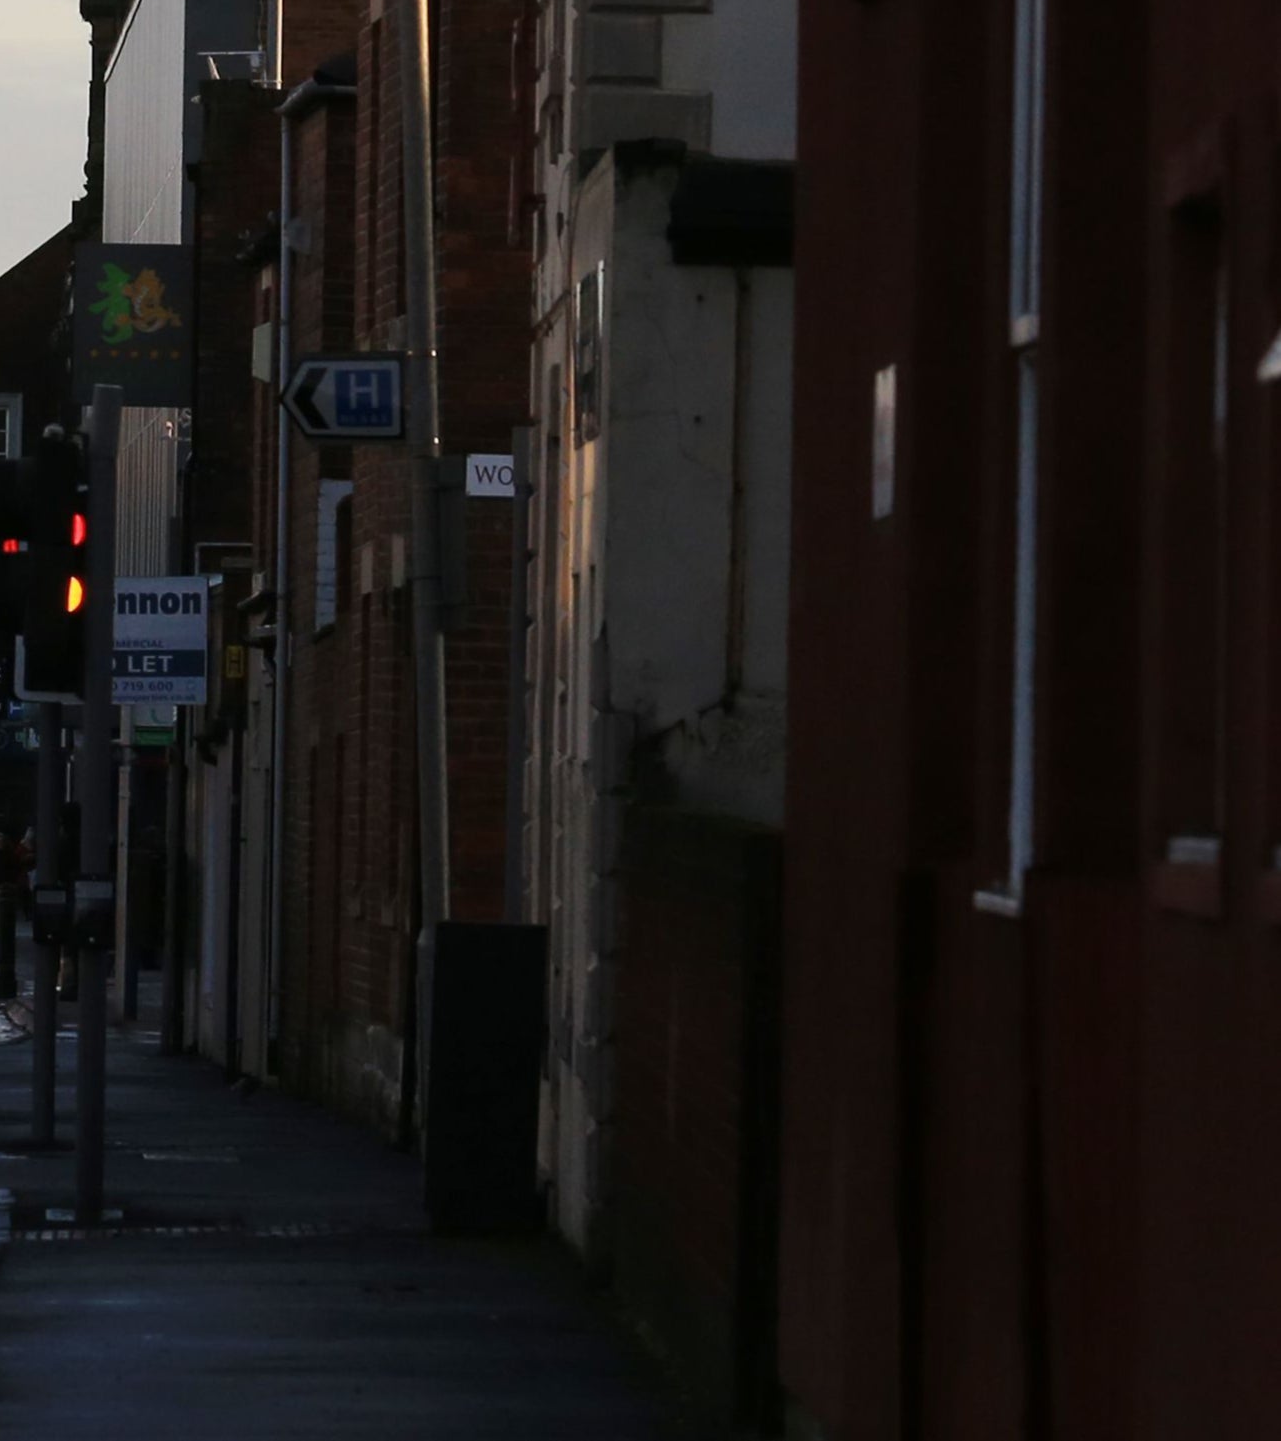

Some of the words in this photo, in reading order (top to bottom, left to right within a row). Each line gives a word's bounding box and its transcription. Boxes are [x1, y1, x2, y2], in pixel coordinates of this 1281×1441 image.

[349, 372, 379, 410] H
[127, 654, 174, 673] LET
[122, 681, 144, 691] 719
[148, 681, 174, 692] 600
